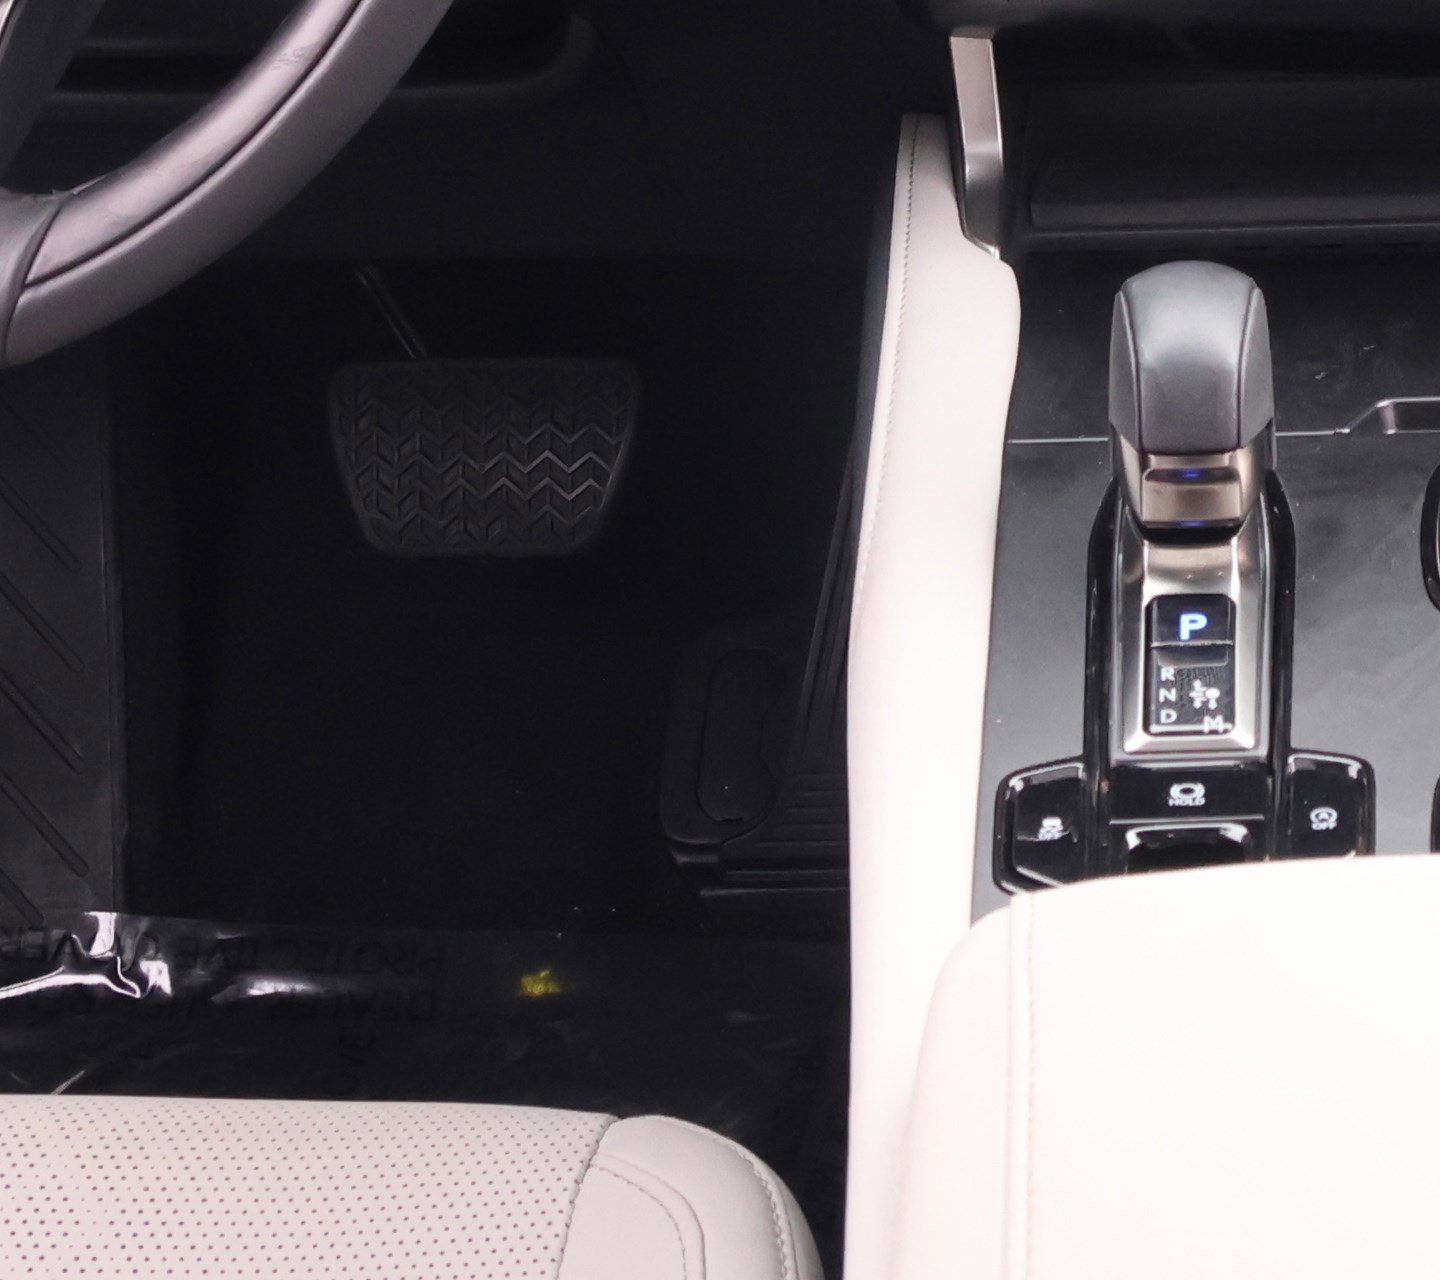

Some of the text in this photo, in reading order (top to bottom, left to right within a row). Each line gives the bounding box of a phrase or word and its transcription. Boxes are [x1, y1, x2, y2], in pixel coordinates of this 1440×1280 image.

[1180, 613, 1208, 640] P
[1161, 666, 1175, 681] R
[1159, 687, 1177, 702] N
[1160, 708, 1177, 724] D
[1202, 714, 1225, 734] M
[1168, 797, 1205, 807] HOLD
